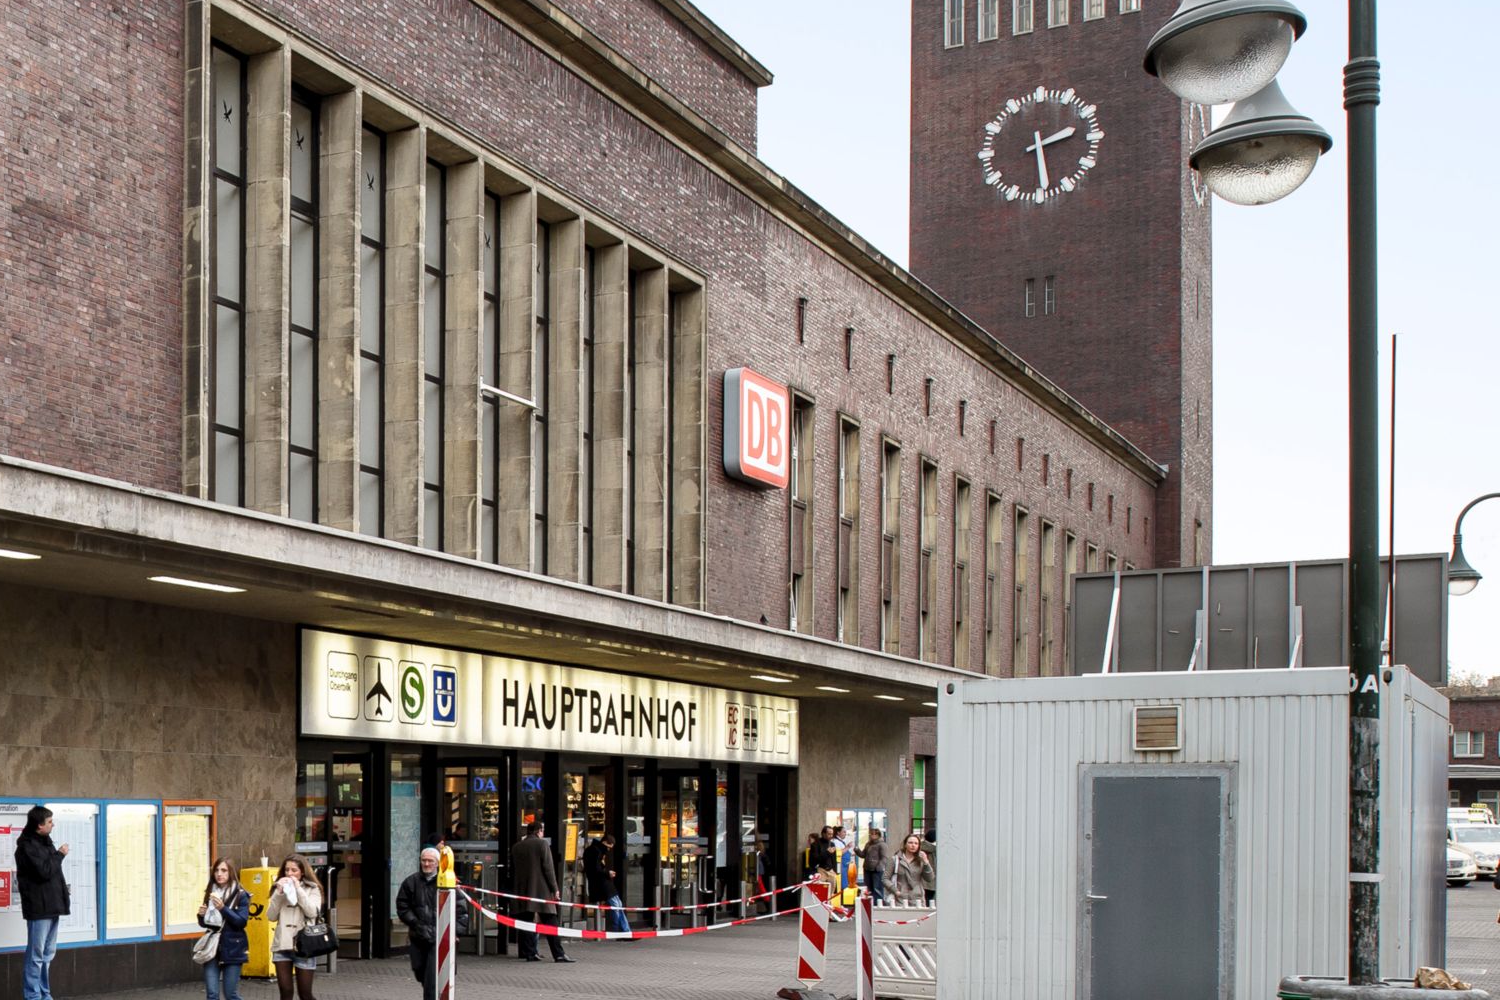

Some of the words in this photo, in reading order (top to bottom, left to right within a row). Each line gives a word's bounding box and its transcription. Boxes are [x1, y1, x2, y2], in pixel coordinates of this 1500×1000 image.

[748, 388, 783, 468] DB
[404, 671, 420, 714] S
[437, 676, 452, 718] U
[502, 678, 697, 742] HAUPTBAHNHOF
[727, 705, 739, 725] EC
[728, 727, 738, 746] IC
